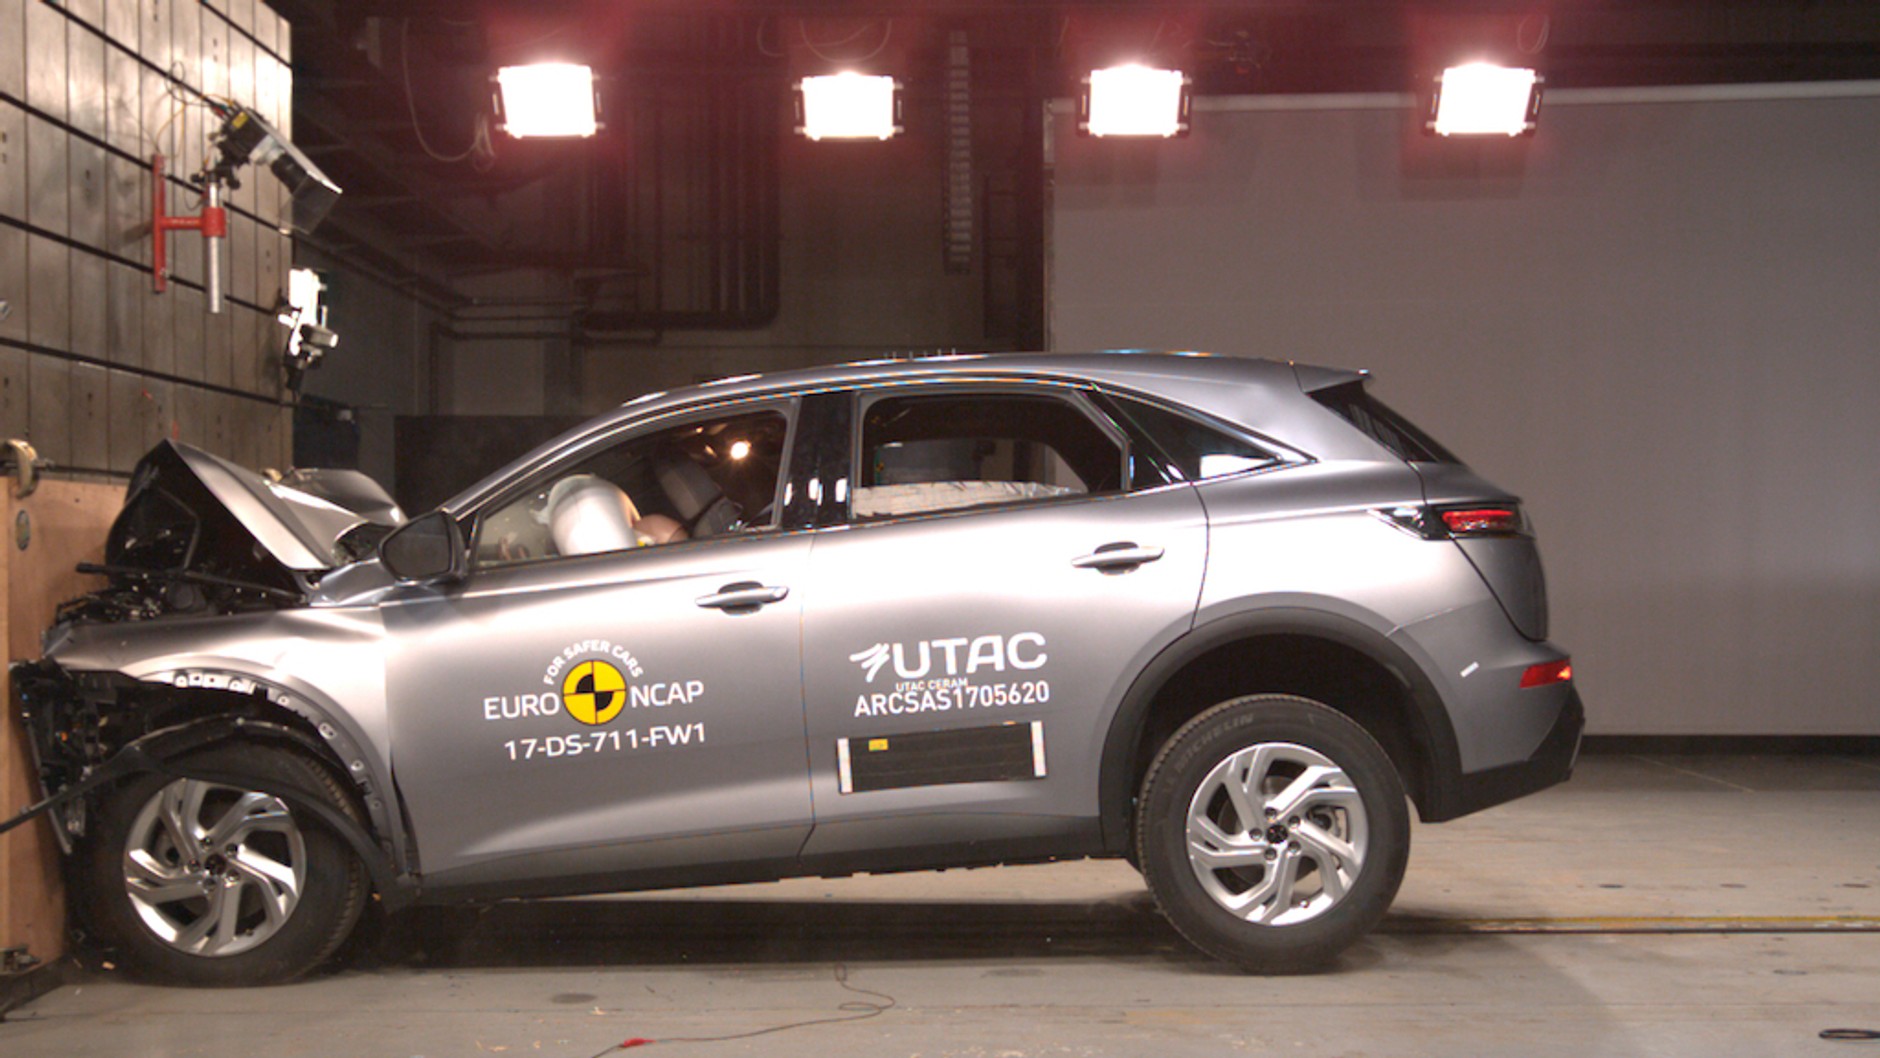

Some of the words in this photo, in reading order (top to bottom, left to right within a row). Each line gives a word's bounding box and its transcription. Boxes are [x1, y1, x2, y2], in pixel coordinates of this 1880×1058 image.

[543, 655, 565, 685] FOR
[563, 639, 610, 660] SAFER
[612, 645, 643, 678] CARS
[892, 632, 1048, 679] UTAC
[483, 692, 560, 720] EURO
[630, 680, 704, 708] NCAP
[854, 680, 1050, 717] ARCSAS1705620
[895, 681, 925, 693] UTAC
[927, 677, 968, 691] CERAM
[504, 722, 705, 760] 17-DS-711-FW1
